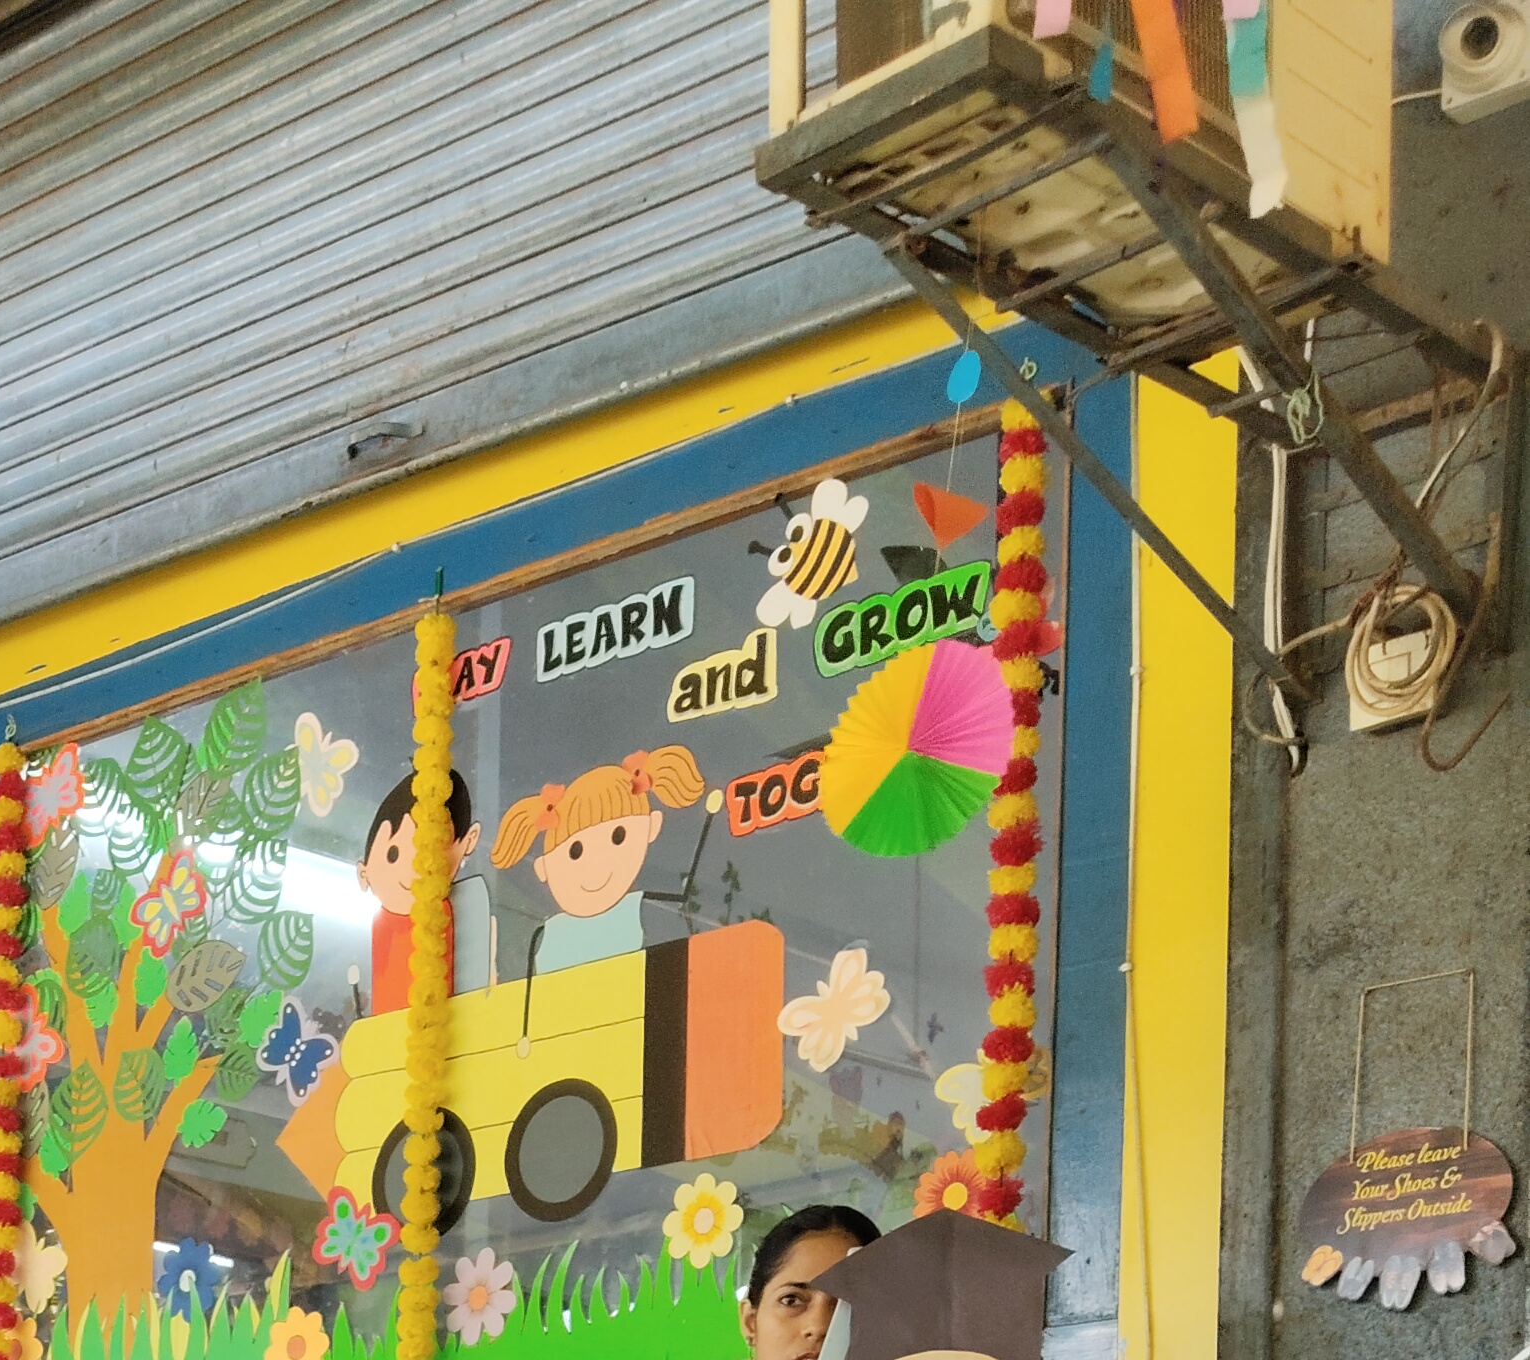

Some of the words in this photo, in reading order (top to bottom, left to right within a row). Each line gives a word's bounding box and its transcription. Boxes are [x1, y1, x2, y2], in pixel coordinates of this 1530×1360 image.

[542, 583, 687, 668] LEARN
[673, 629, 770, 713] and
[821, 573, 983, 665] GROW
[1356, 1149, 1415, 1173] Please
[1417, 1143, 1461, 1165] leave
[1352, 1179, 1388, 1200] Your
[1389, 1173, 1436, 1200] Shoes
[1440, 1166, 1462, 1188] &
[1336, 1206, 1406, 1235] Slippers
[1407, 1193, 1473, 1221] Outside
